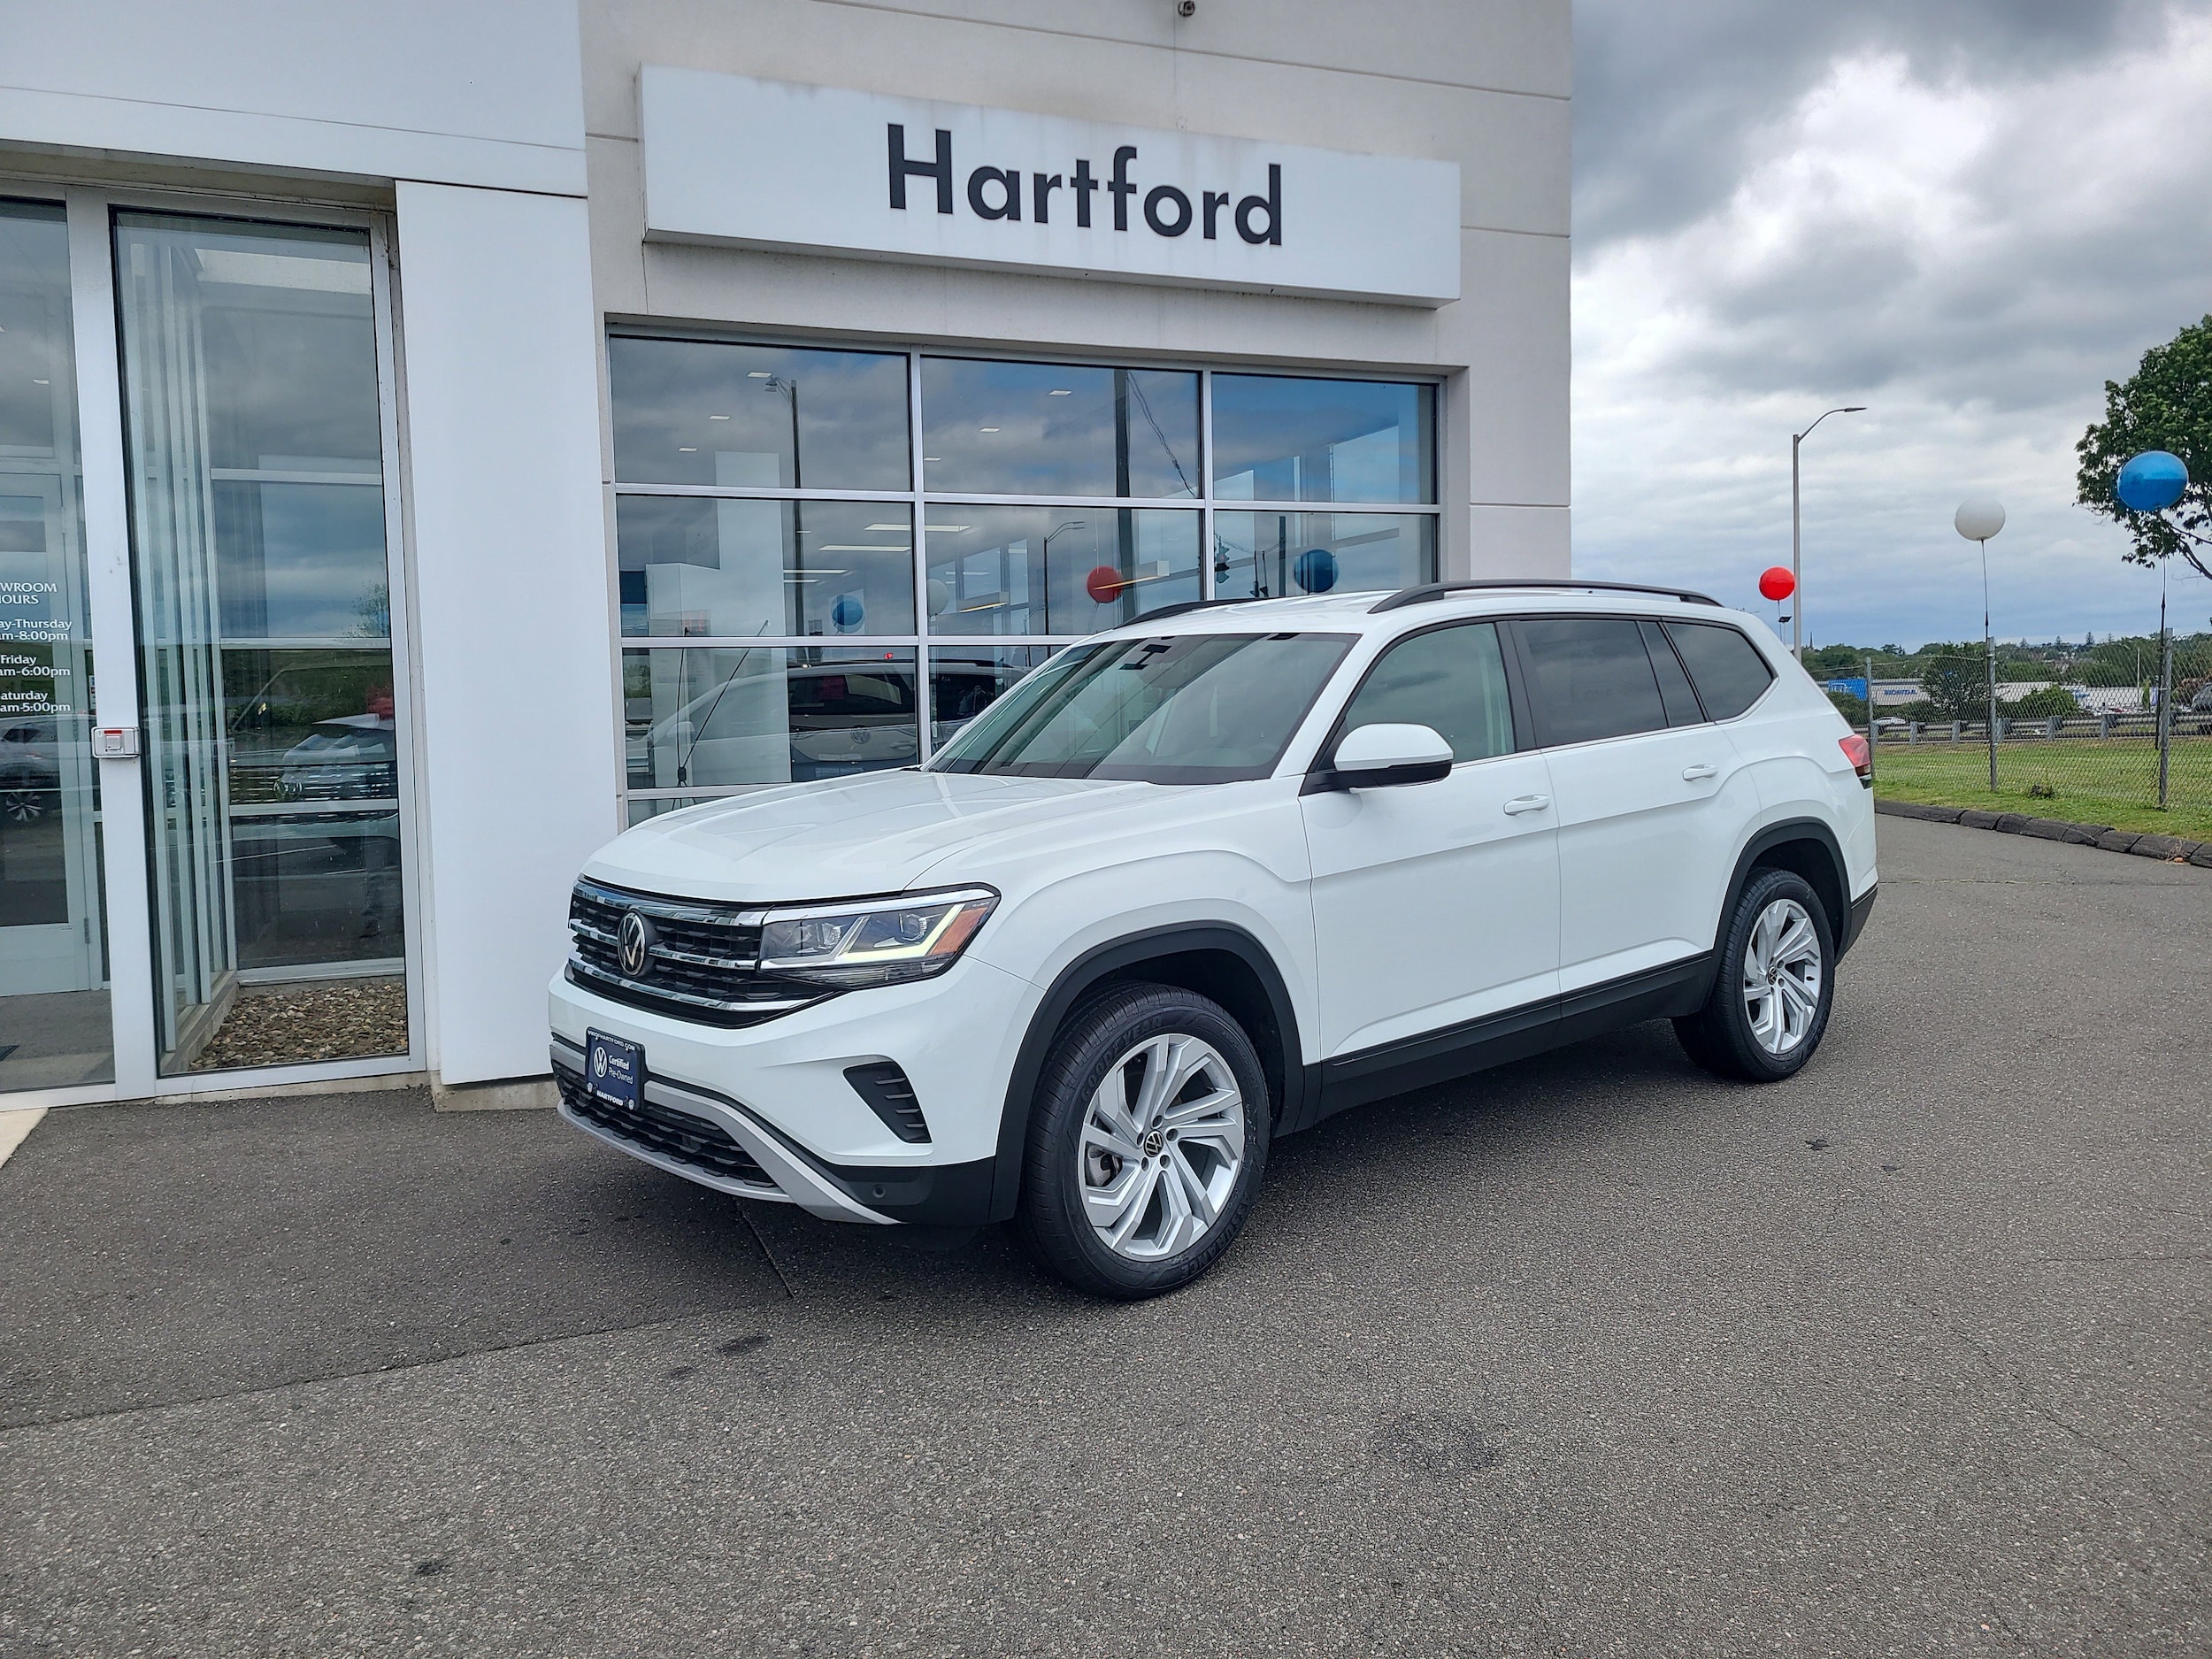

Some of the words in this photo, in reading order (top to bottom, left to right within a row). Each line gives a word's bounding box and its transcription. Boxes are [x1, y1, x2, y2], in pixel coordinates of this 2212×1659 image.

[887, 123, 1282, 246] Hartford
[0, 595, 39, 604] OURS
[0, 655, 37, 665] Friday
[609, 1055, 630, 1071] Certified
[609, 1067, 634, 1085] Pre-Owned
[596, 1089, 624, 1106] HARTFORD
